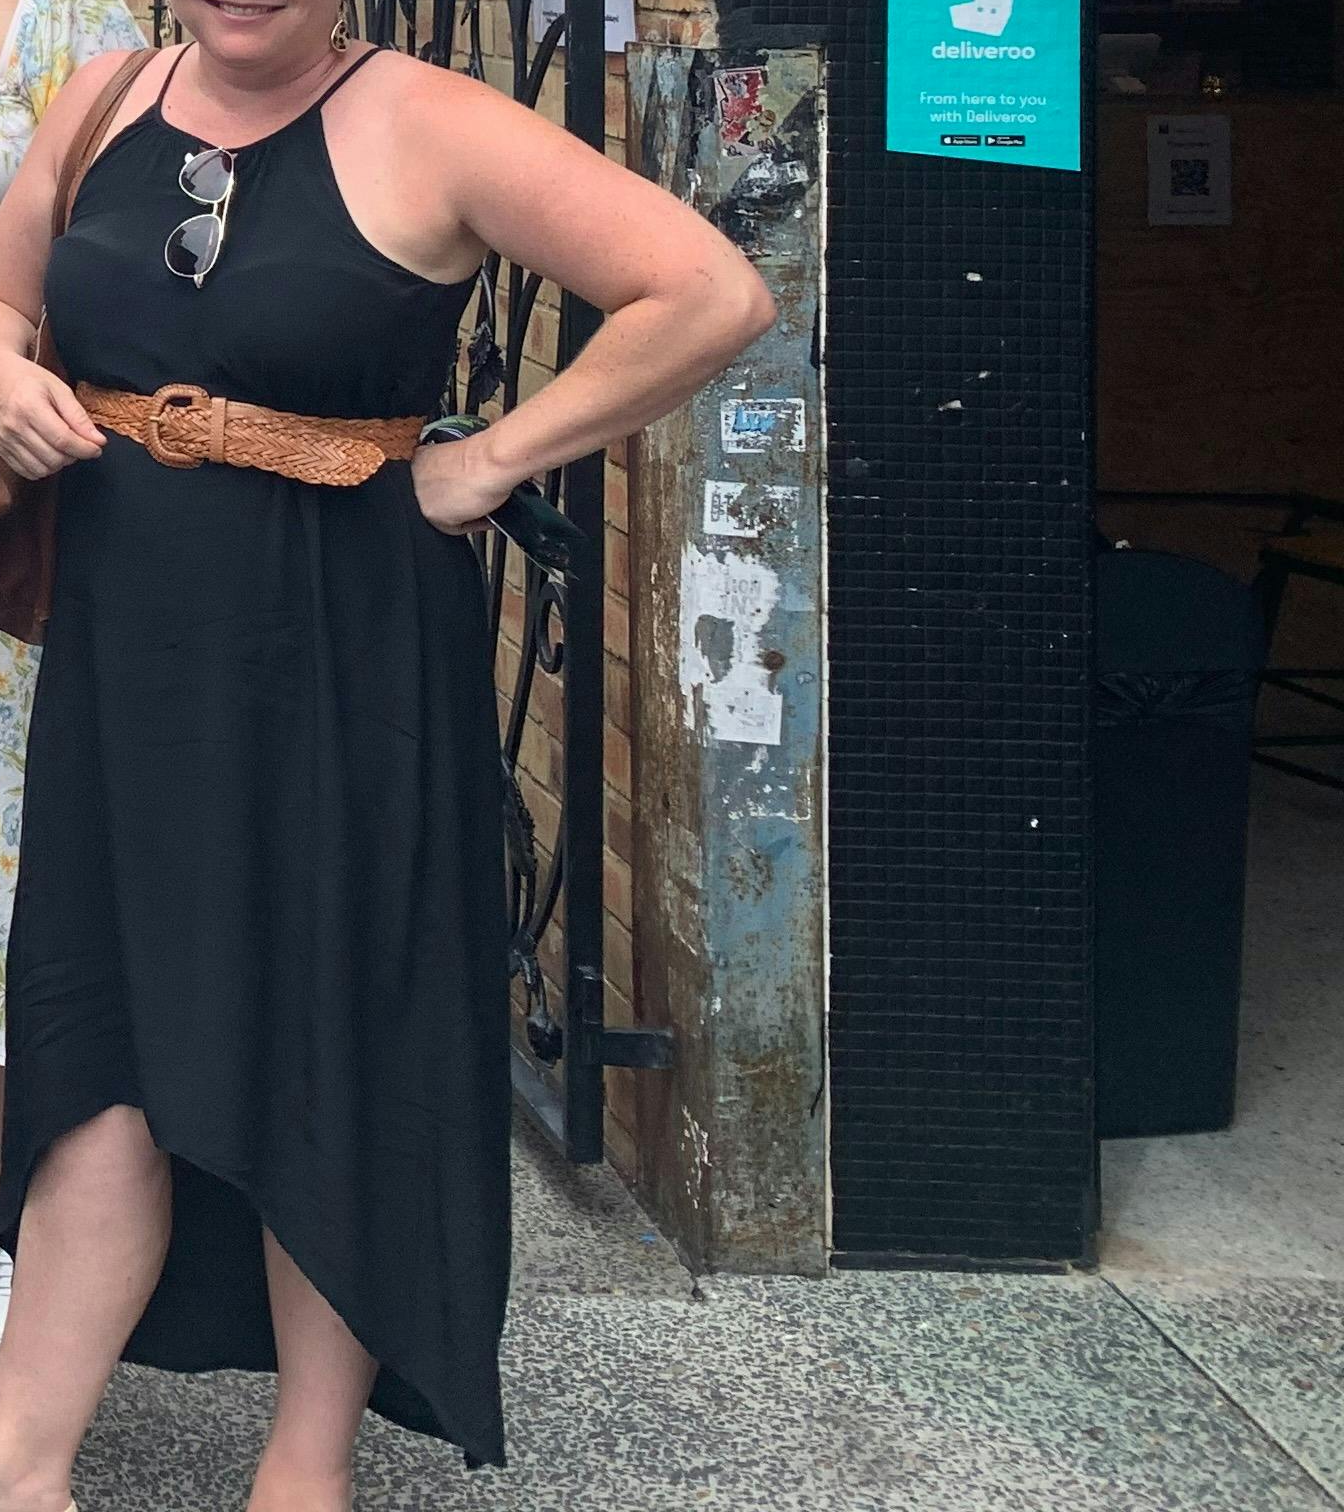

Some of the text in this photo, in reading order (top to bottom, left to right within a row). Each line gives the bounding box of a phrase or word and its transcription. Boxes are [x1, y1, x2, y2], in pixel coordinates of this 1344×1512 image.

[931, 40, 1036, 59] deliveroo
[919, 91, 1048, 109] From here to you
[929, 109, 1038, 124] with Deliveroo
